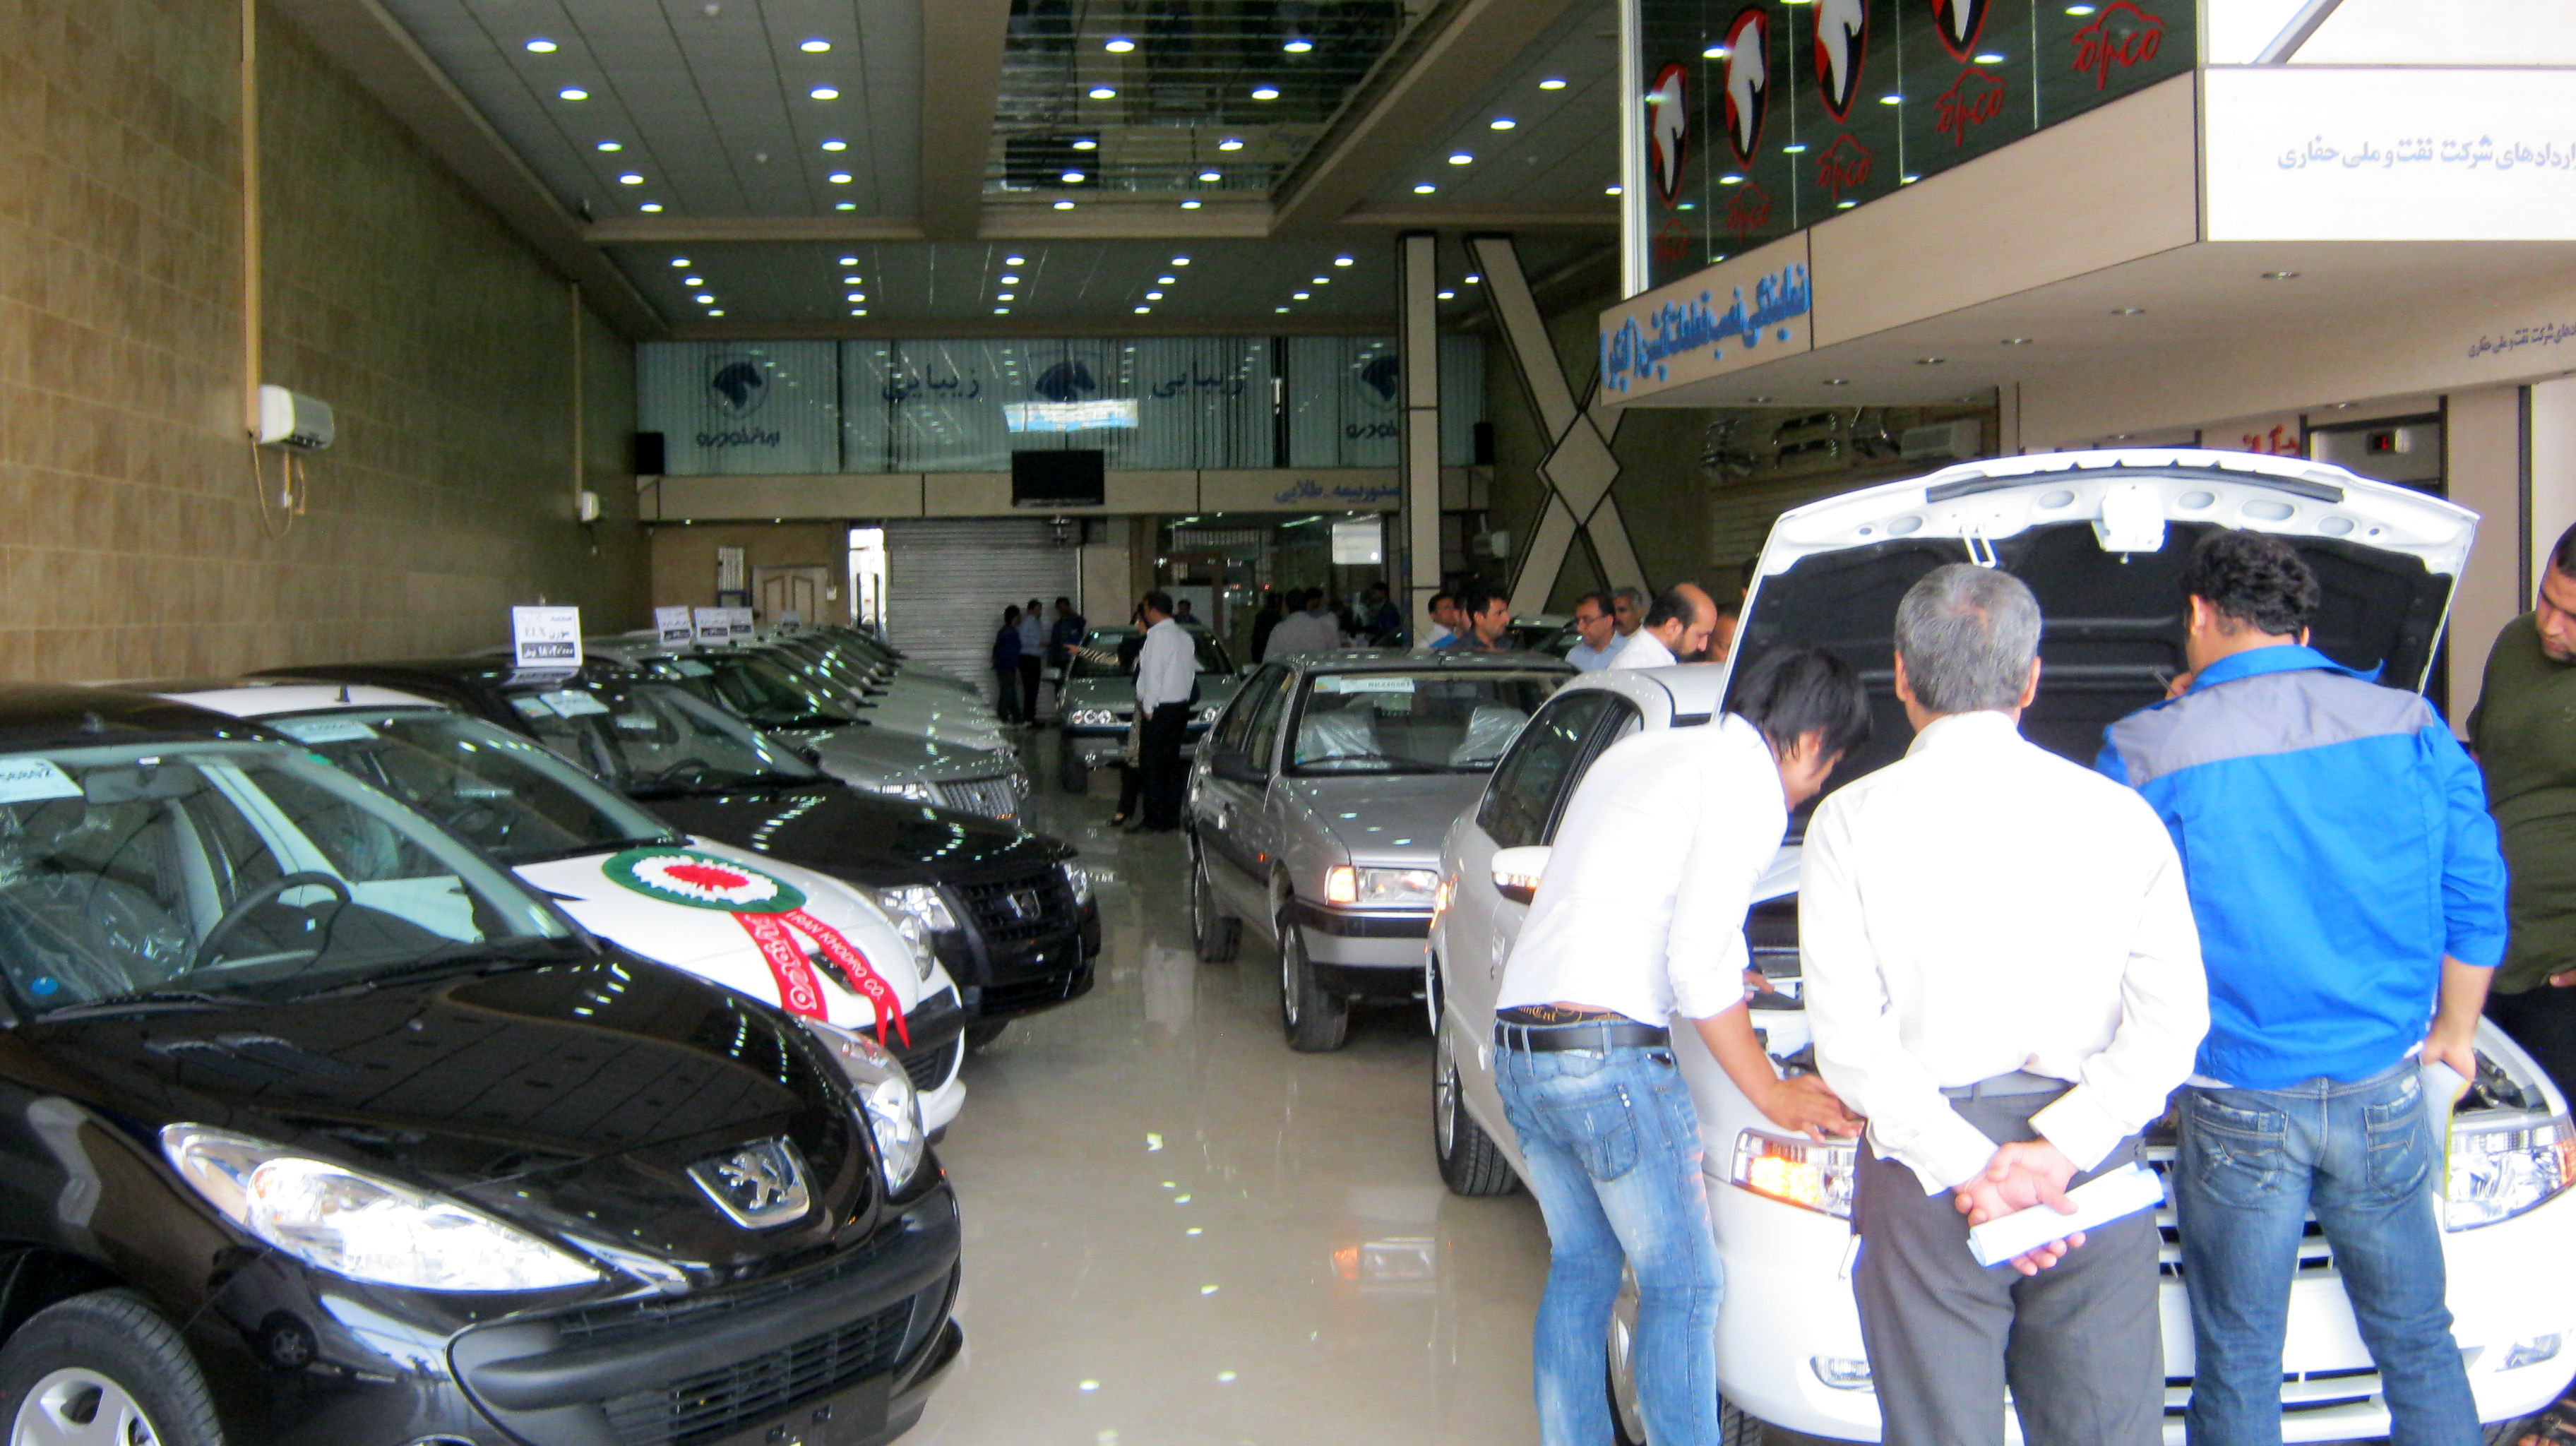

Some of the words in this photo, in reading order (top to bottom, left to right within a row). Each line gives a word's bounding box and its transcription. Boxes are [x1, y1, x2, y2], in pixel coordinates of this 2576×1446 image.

[2277, 135, 2339, 169] حفاری
[2342, 141, 2380, 168] ملی
[2383, 150, 2395, 169] و
[2396, 138, 2433, 162] نفت
[2440, 134, 2493, 169] شرکت
[786, 911, 824, 934] IRAN
[819, 931, 868, 978] KHODRO
